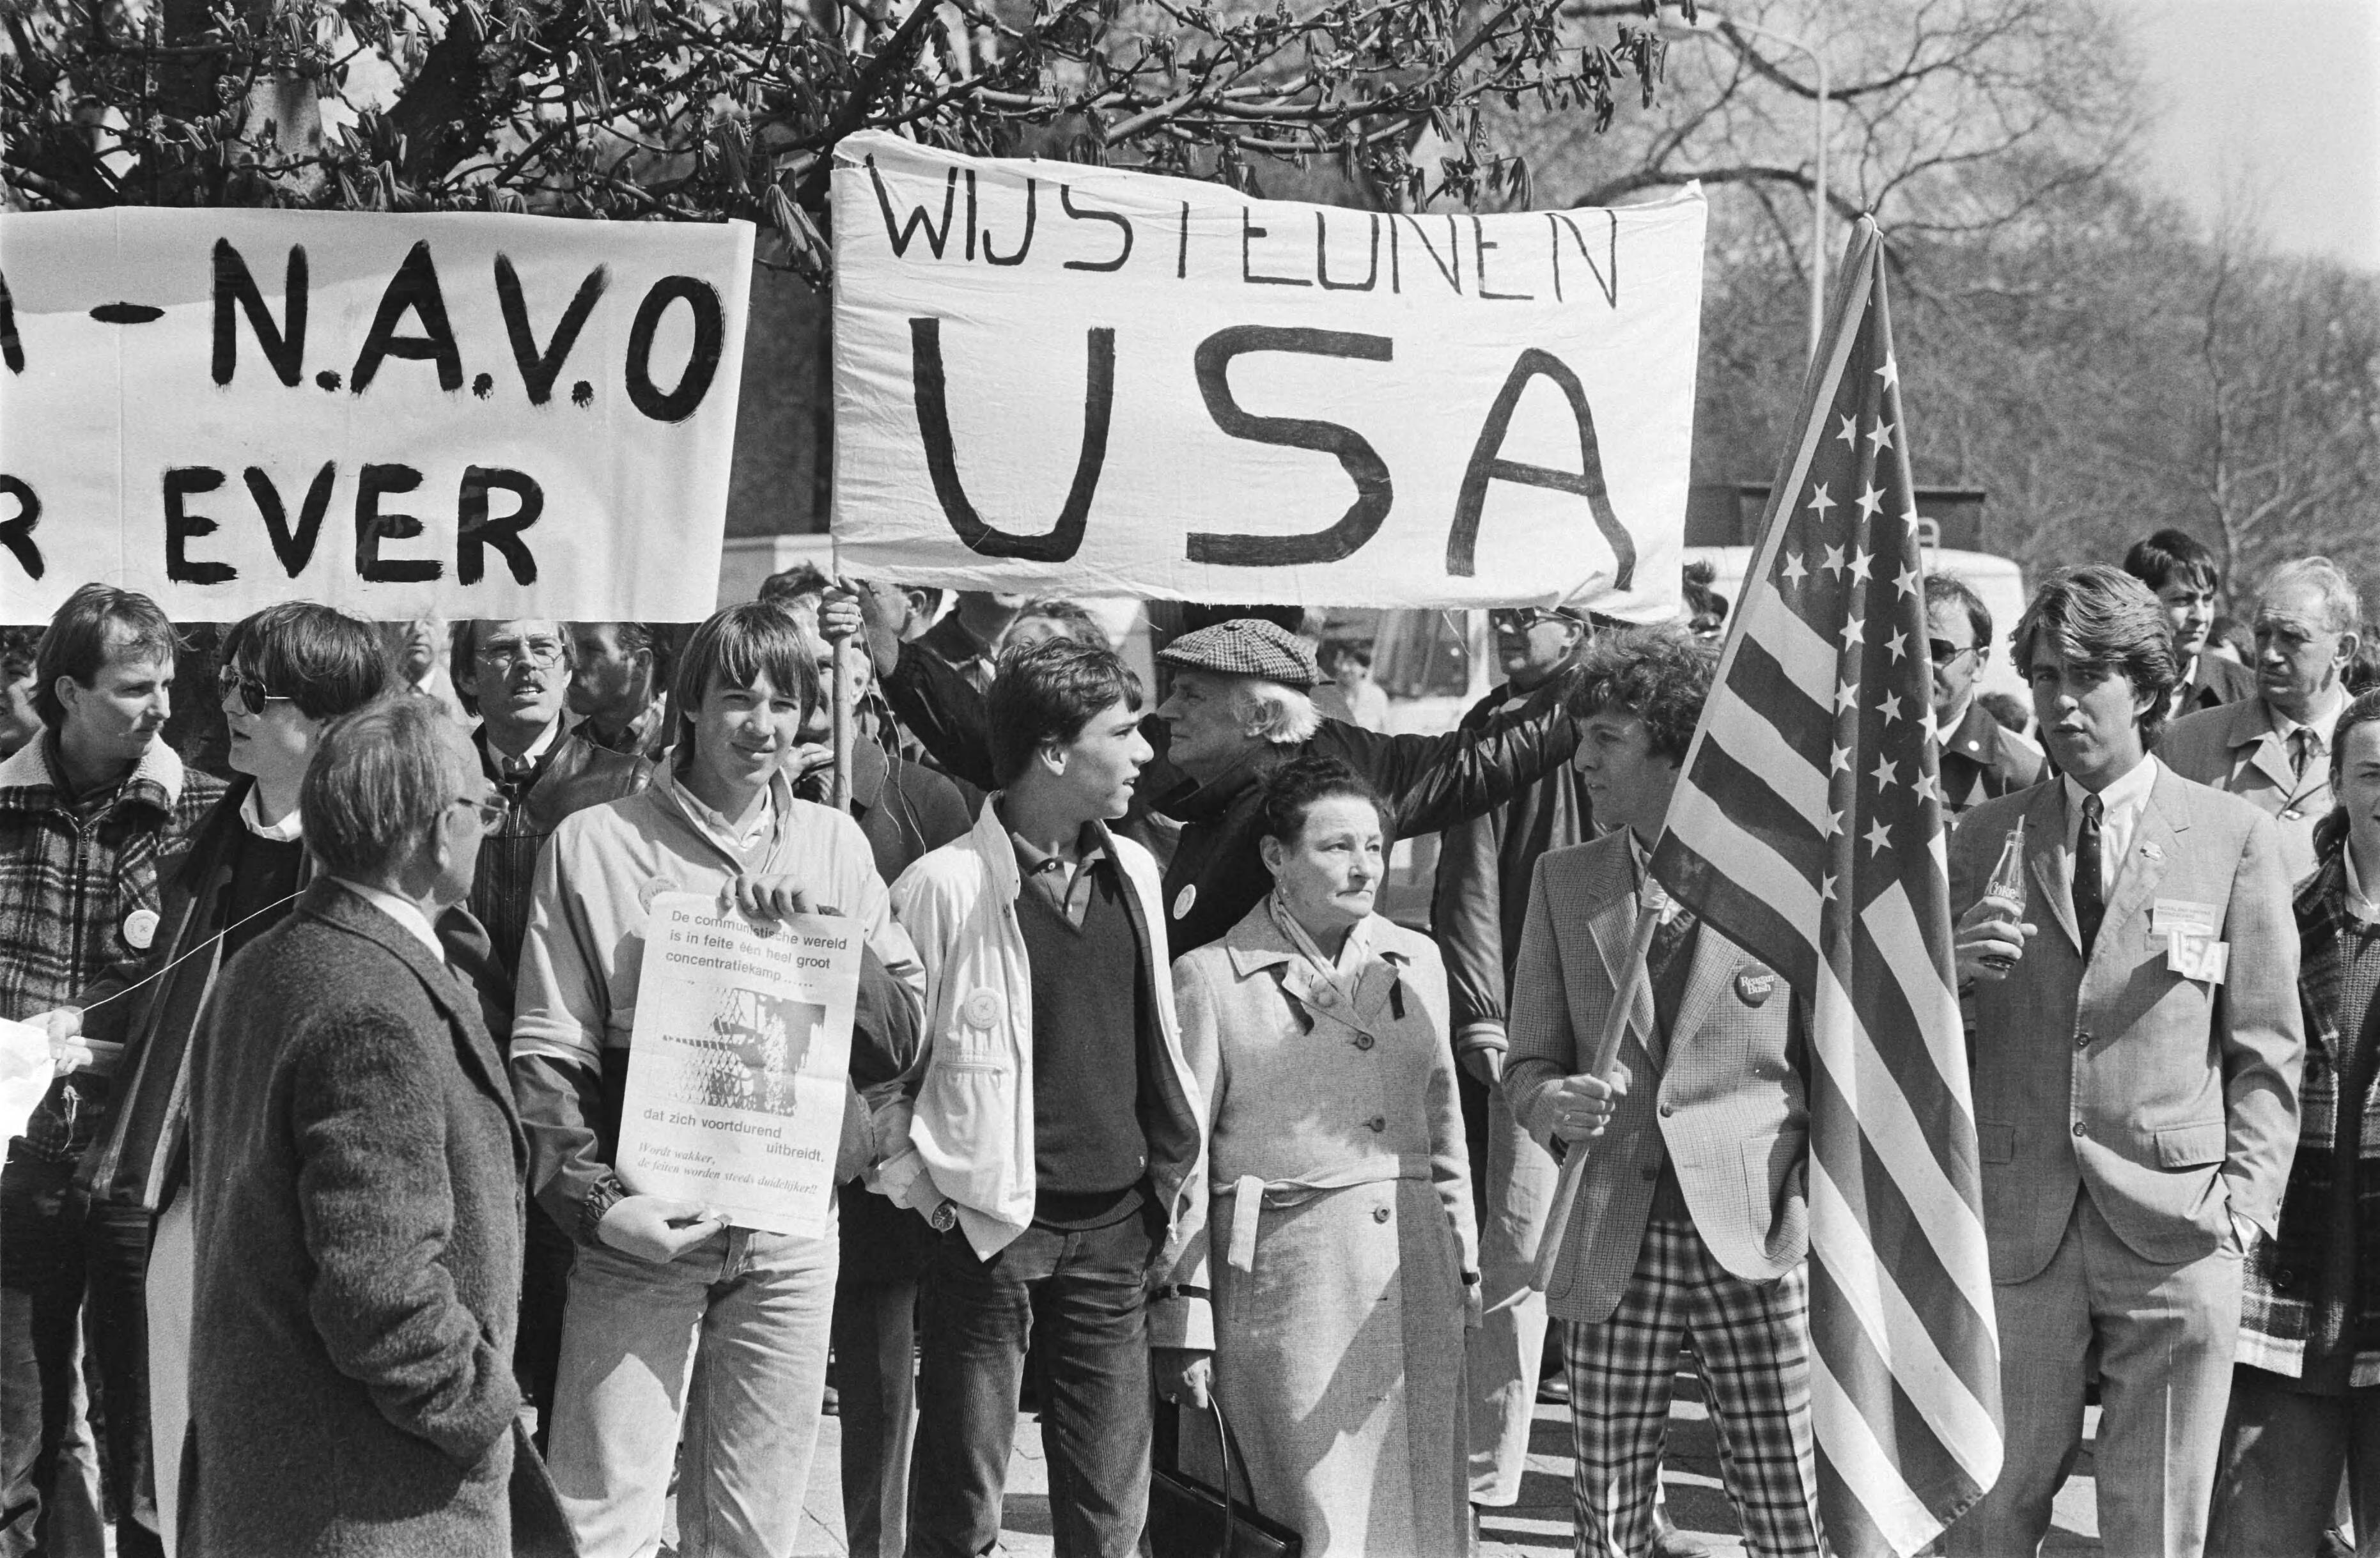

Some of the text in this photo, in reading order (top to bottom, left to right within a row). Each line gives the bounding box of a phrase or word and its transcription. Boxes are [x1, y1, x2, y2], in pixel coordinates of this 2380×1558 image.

[212, 237, 725, 424] N.A.V.O
[908, 318, 1636, 592] USA
[163, 460, 544, 586] EVER
[1990, 882, 2016, 899] Coke
[672, 910, 847, 950] De communistische wereld
[670, 930, 830, 969] is in feite één heel groot
[1741, 975, 1775, 986] Reagan
[1748, 983, 1771, 994] Bush
[644, 1108, 782, 1139] dat zich voortdurend
[639, 1142, 716, 1165] Wordt wakker,
[766, 1142, 824, 1162] uitbreidt.
[637, 1158, 649, 1167] de
[653, 1161, 680, 1174] feiten
[684, 1167, 720, 1179] worden
[724, 1172, 755, 1183] steeds
